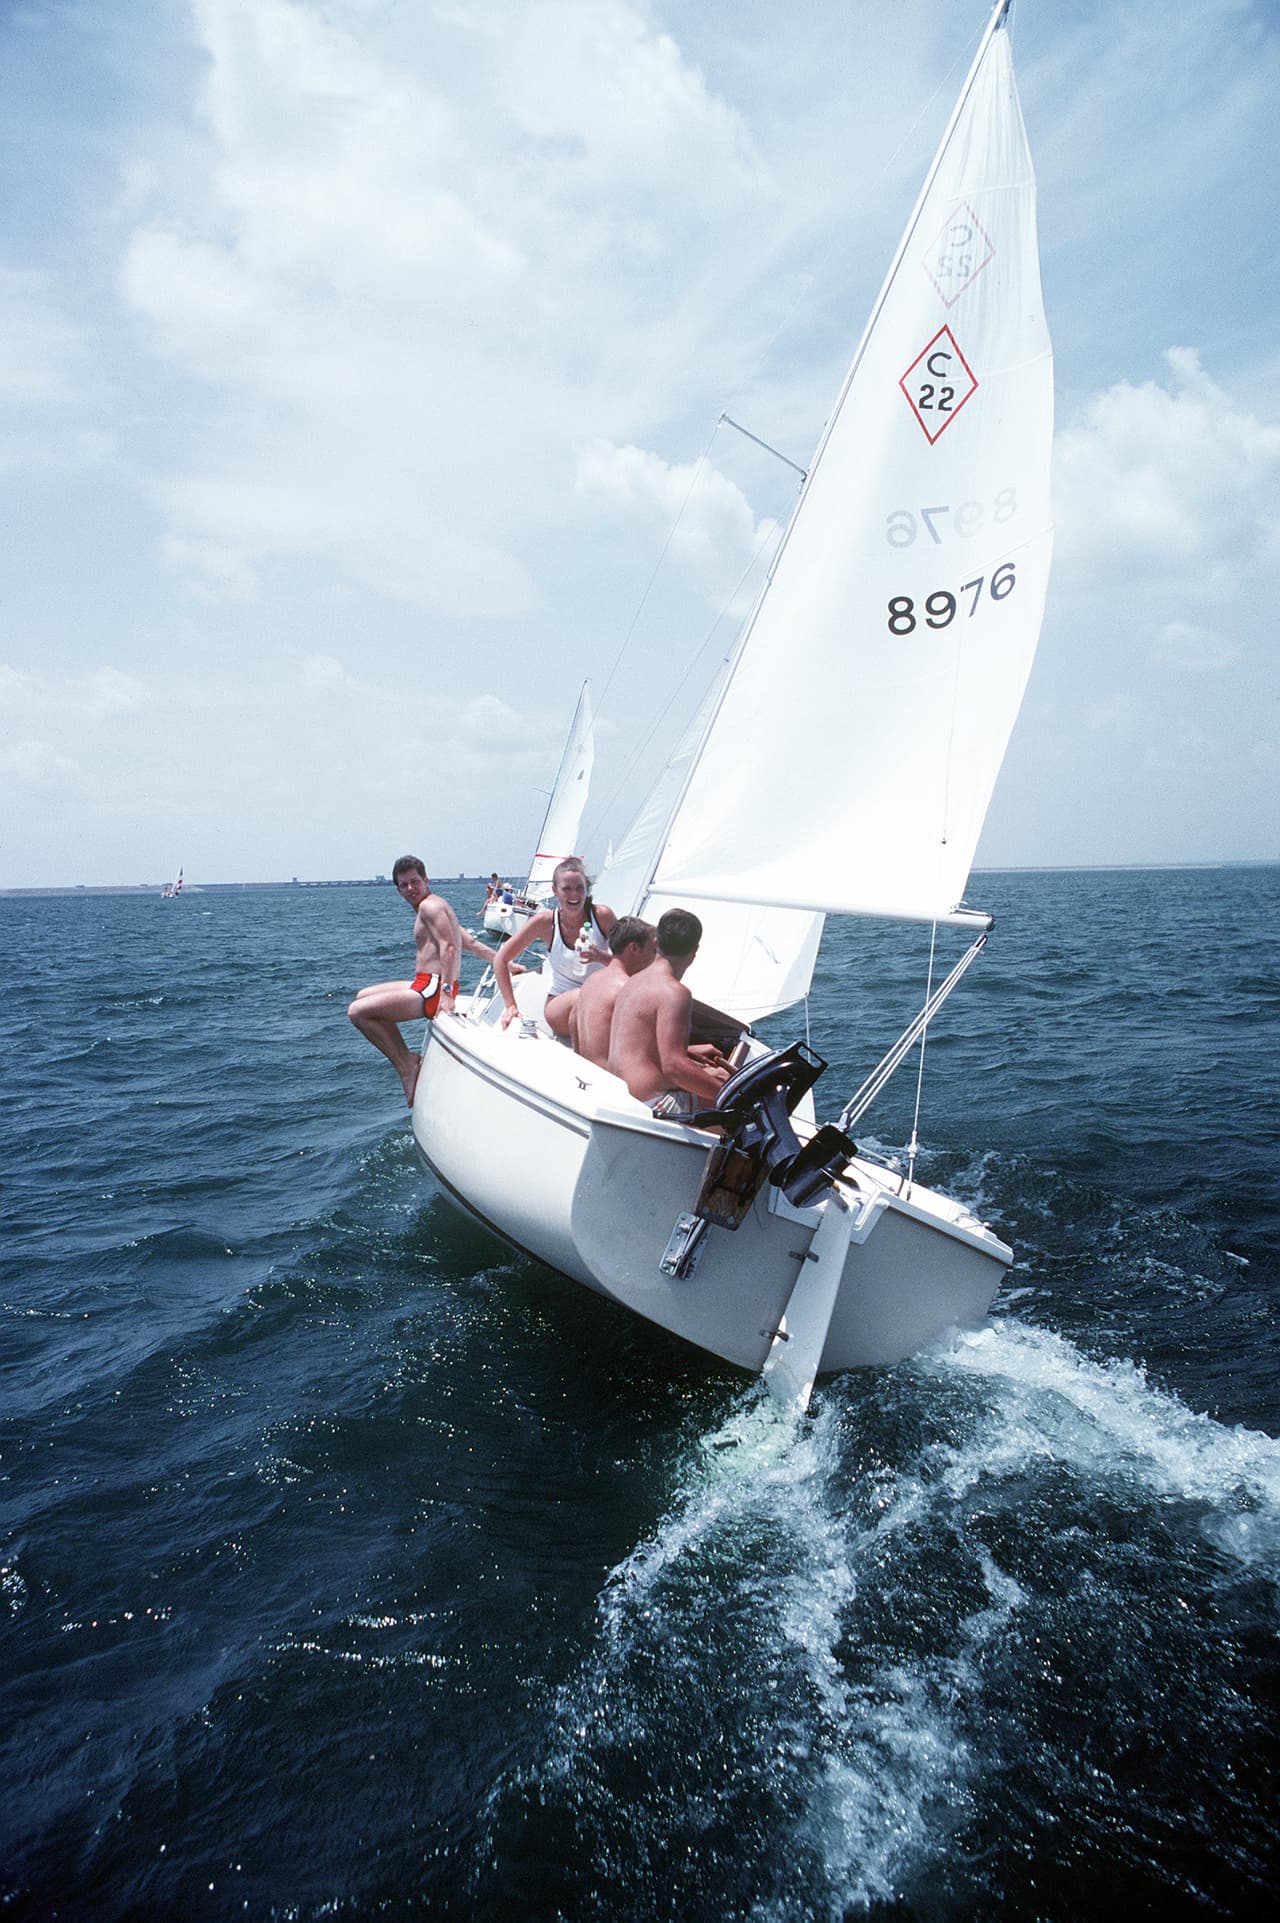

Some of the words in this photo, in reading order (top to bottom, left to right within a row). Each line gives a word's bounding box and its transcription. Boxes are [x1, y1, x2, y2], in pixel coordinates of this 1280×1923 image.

[927, 352, 952, 378] C
[919, 384, 955, 411] 22
[887, 562, 1016, 635] 8976
